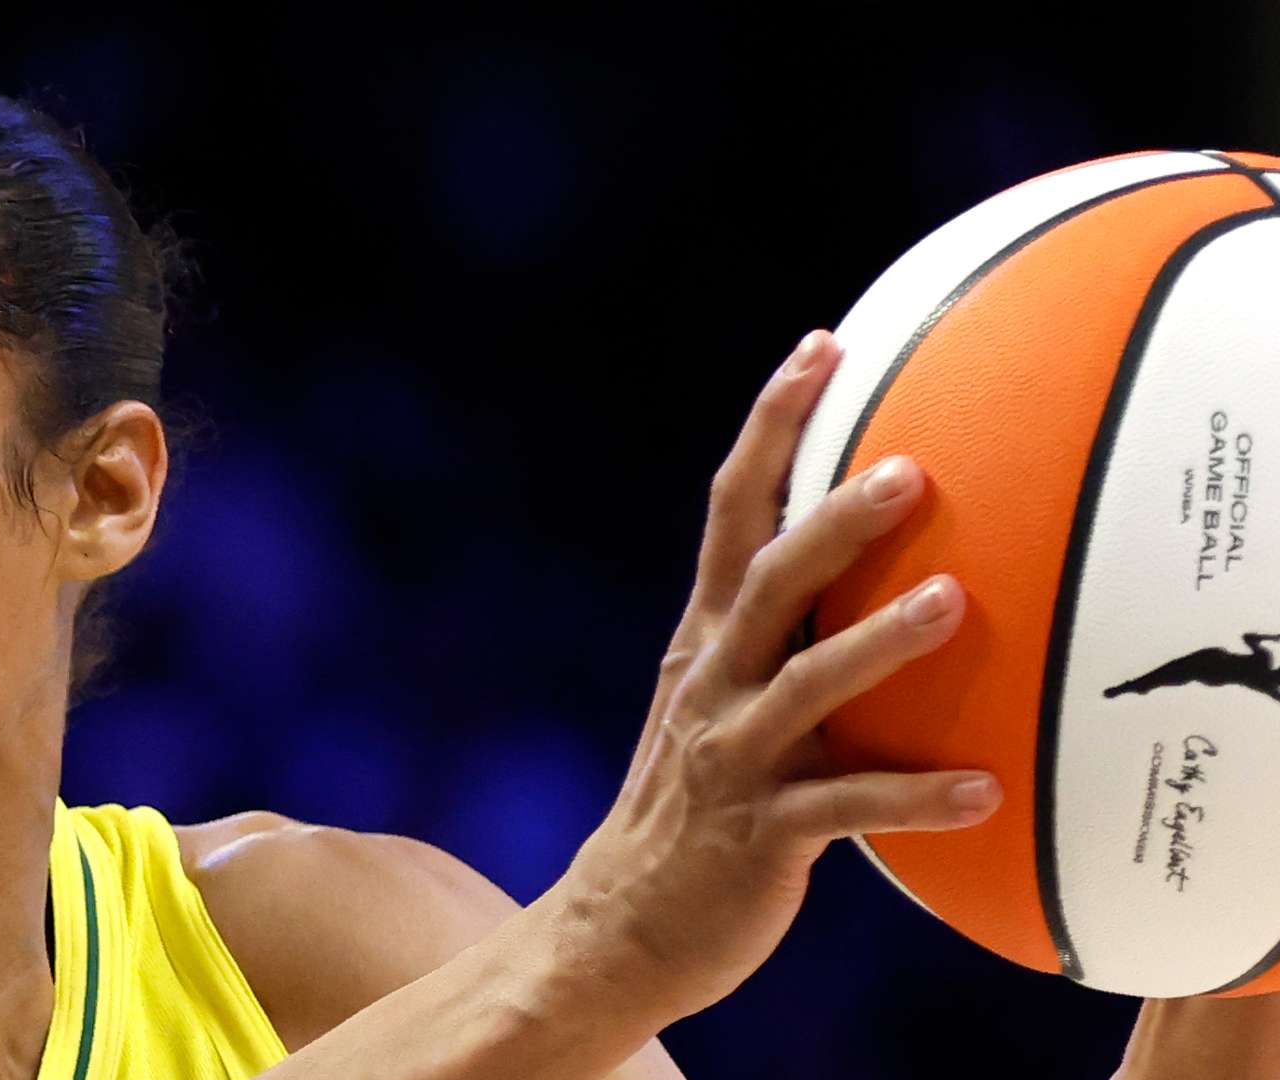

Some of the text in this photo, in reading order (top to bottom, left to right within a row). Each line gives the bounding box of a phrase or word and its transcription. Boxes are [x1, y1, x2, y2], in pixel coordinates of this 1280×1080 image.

[1180, 468, 1197, 525] WNBA
[1196, 410, 1229, 592] GAME BALL
[1224, 432, 1254, 573] OFFICIAL
[1164, 734, 1219, 794] Cathy
